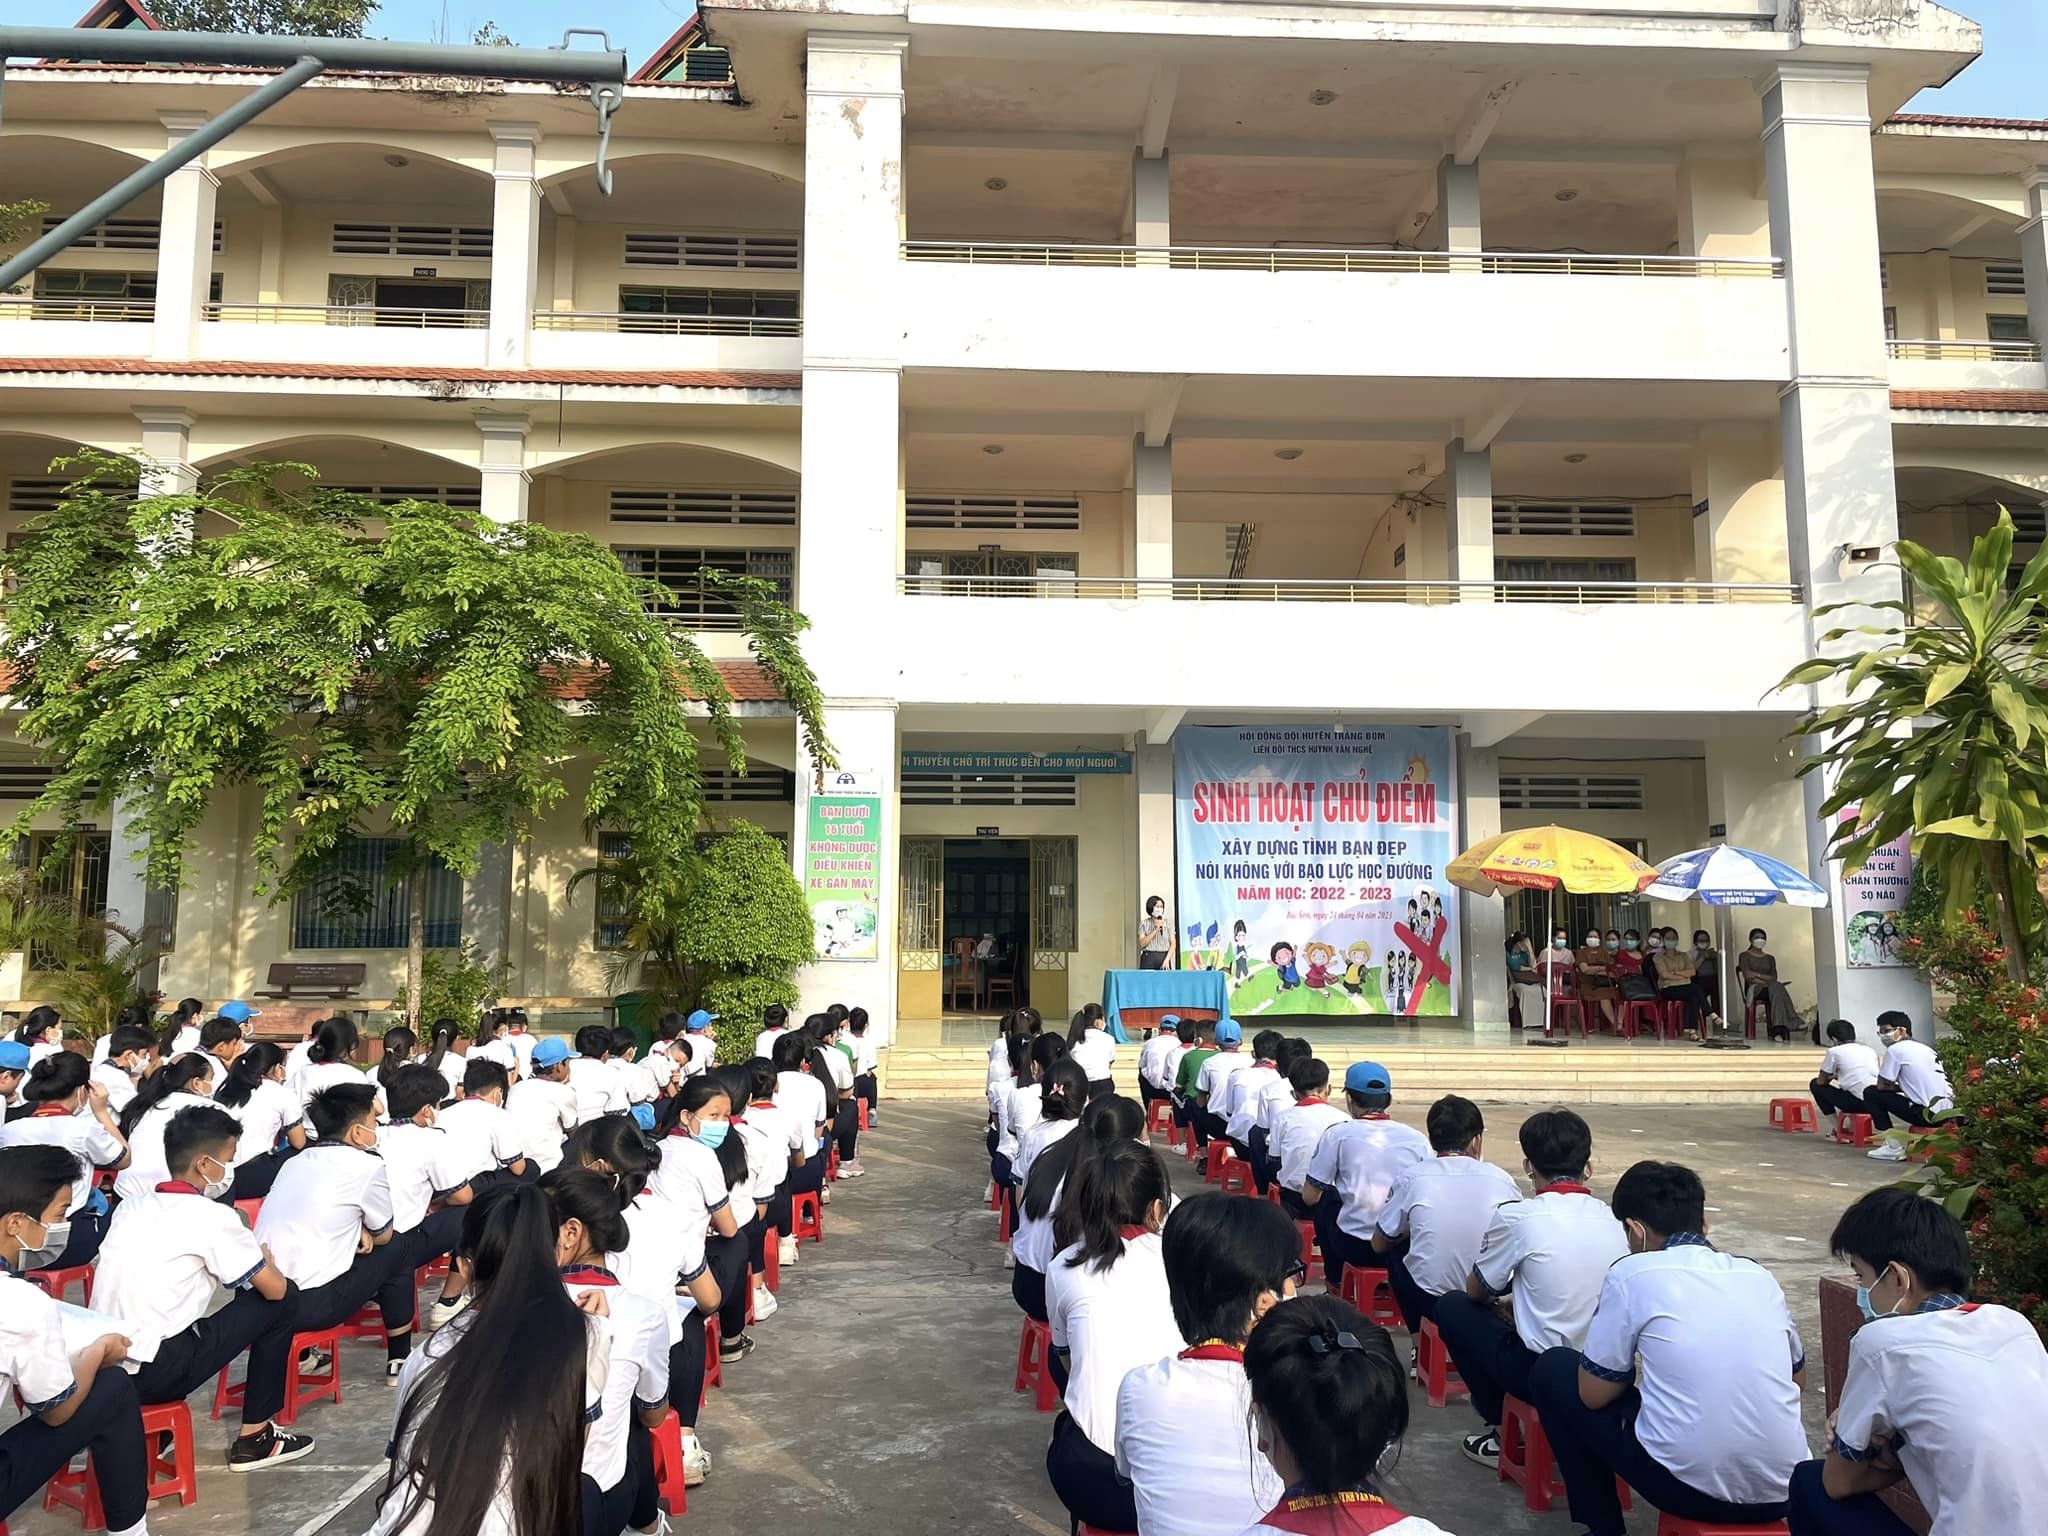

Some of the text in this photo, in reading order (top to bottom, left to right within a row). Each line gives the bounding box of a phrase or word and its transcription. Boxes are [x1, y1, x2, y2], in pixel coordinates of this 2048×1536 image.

[1287, 744, 1306, 754] THCS
[1043, 757, 1063, 768] CHO
[1192, 767, 1436, 831] SINH HOẠT CHỦ ĐIỂM
[1222, 837, 1407, 859] XÂY DỰNG TÌNH BẠN ĐẸP
[1195, 860, 1433, 883] NÓI KHÔNG VỚI BẠO LỰC HỌC ĐƯỜNG
[1237, 884, 1271, 900] NĂM
[1276, 887, 1306, 903] HỌC:
[1310, 886, 1345, 900] 2022
[1360, 887, 1392, 900] 2023
